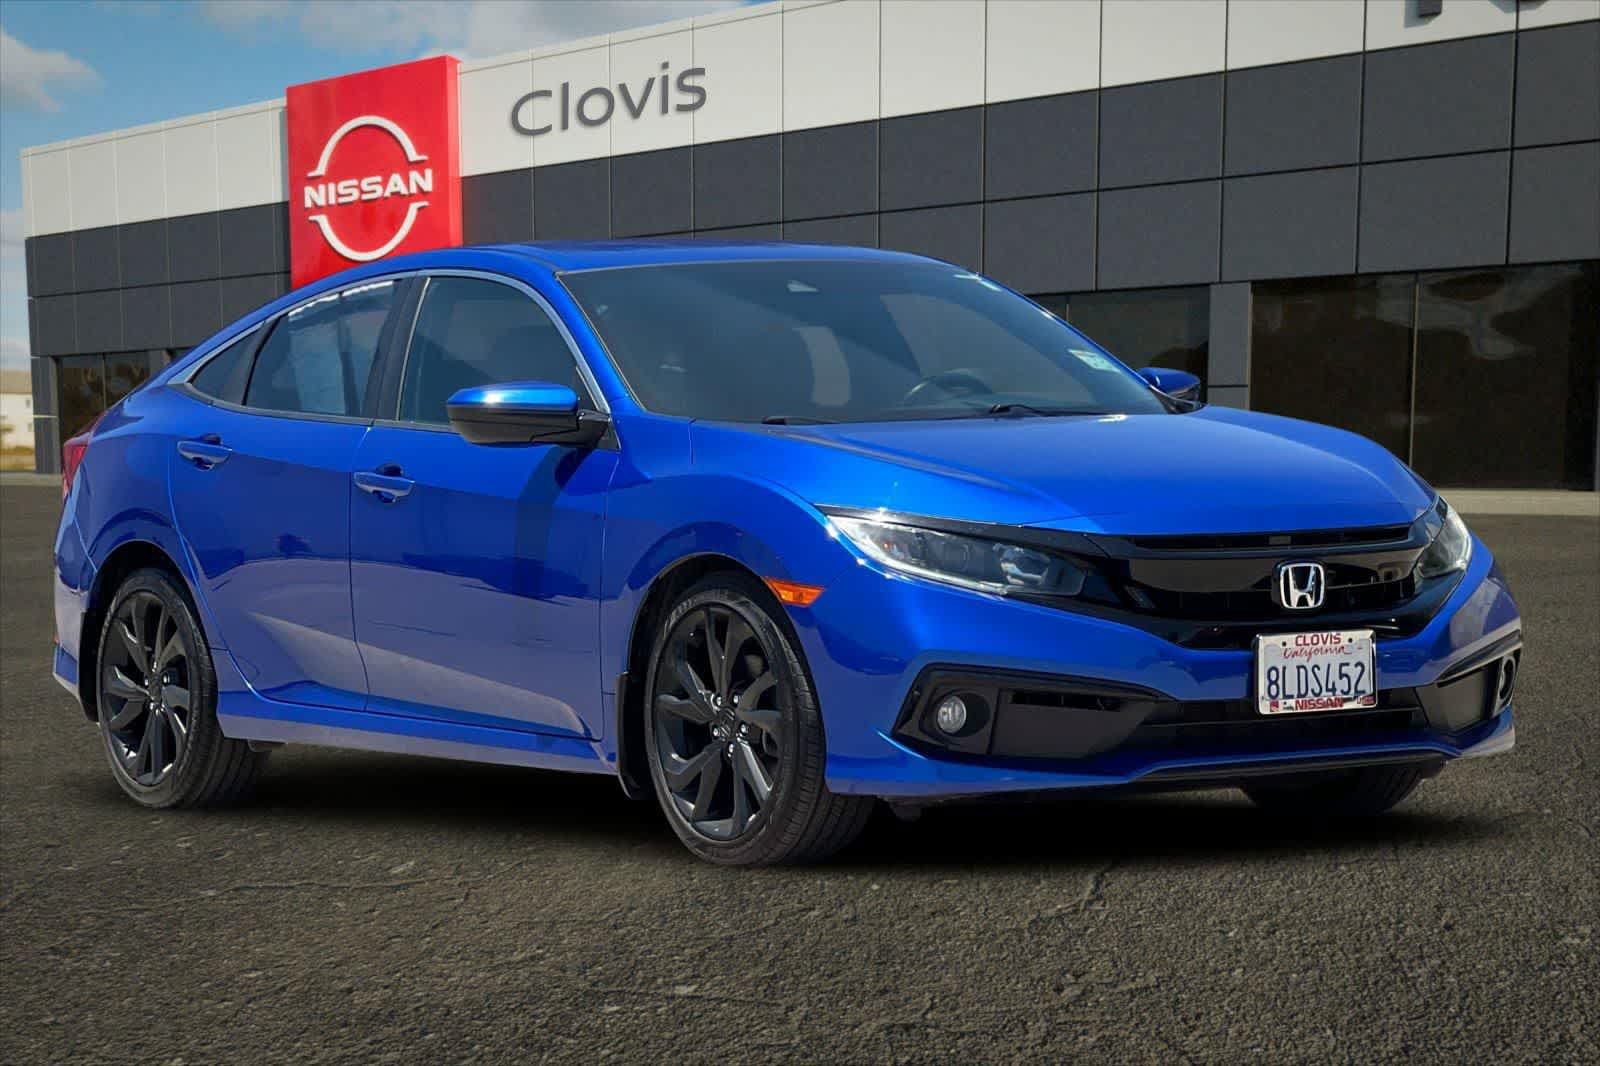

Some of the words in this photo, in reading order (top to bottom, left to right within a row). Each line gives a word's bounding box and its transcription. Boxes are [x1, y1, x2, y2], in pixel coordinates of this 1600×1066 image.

[510, 61, 708, 136] Clovis
[303, 168, 434, 209] NISSAN
[1295, 632, 1342, 647] CLOVIS
[1283, 646, 1352, 662] California
[1266, 661, 1366, 700] 8LDS452
[1295, 697, 1344, 710] NISSAN
